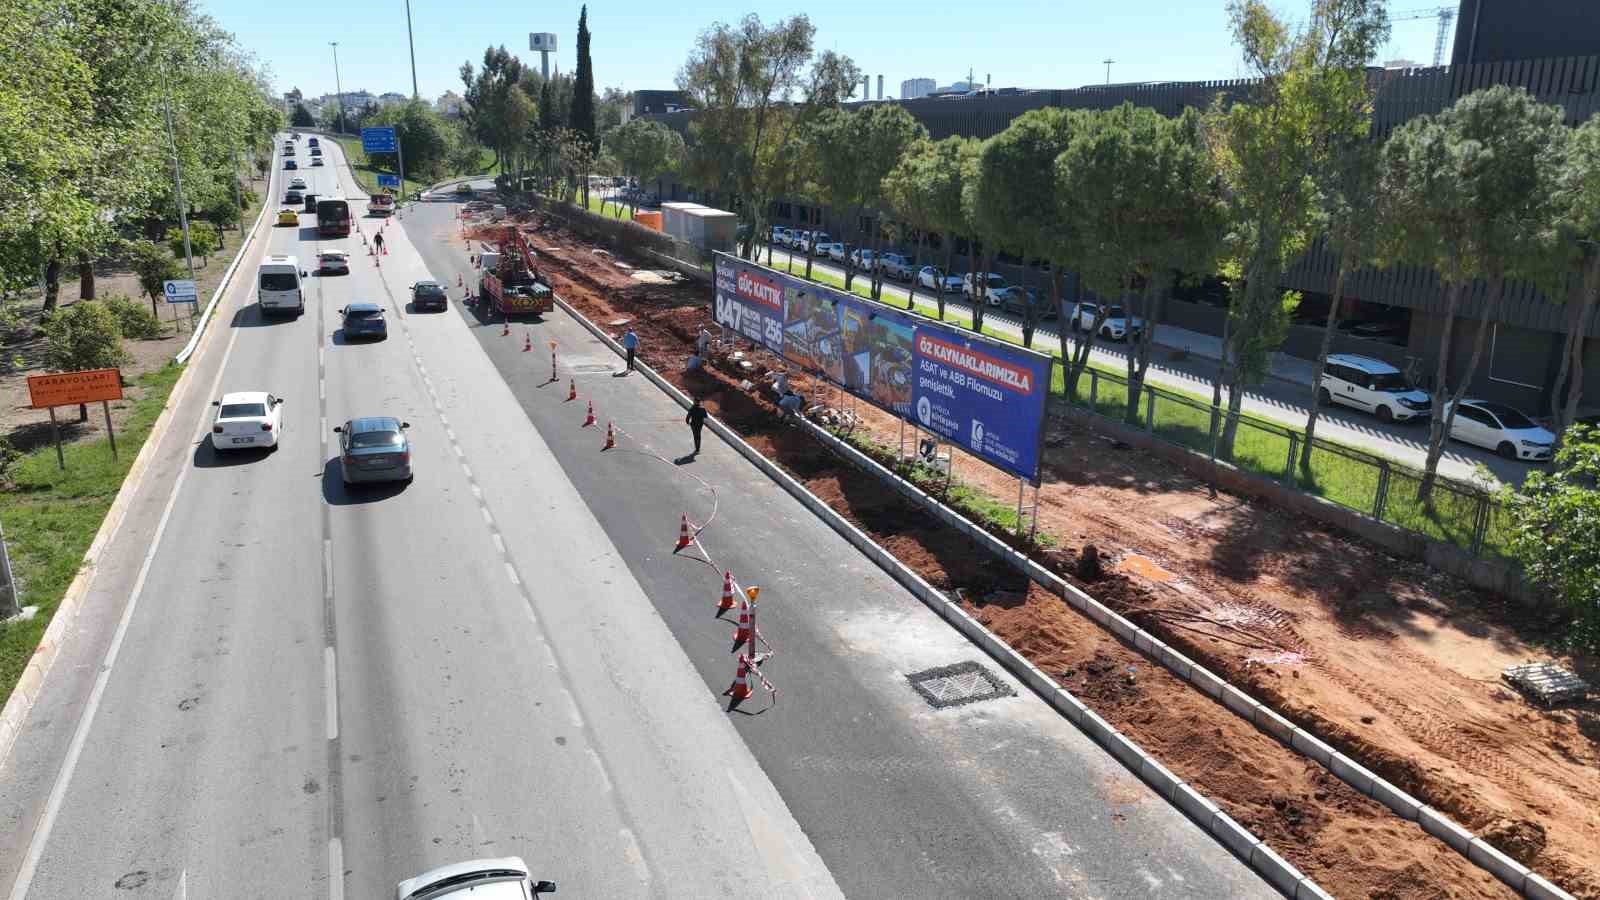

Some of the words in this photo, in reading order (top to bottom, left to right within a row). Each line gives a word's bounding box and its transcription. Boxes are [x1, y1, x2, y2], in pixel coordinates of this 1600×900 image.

[753, 281, 781, 305] KATTIK
[716, 294, 742, 330] 847
[764, 317, 783, 344] 256
[919, 335, 933, 354] ÖZ
[933, 344, 1030, 391] KAYNAKLARIMIZLA
[37, 374, 110, 387] KARAYOLLARI
[919, 360, 938, 375] ASAT
[939, 368, 948, 379] ve
[949, 371, 965, 386] ABB
[966, 377, 1003, 401] Filomuzu
